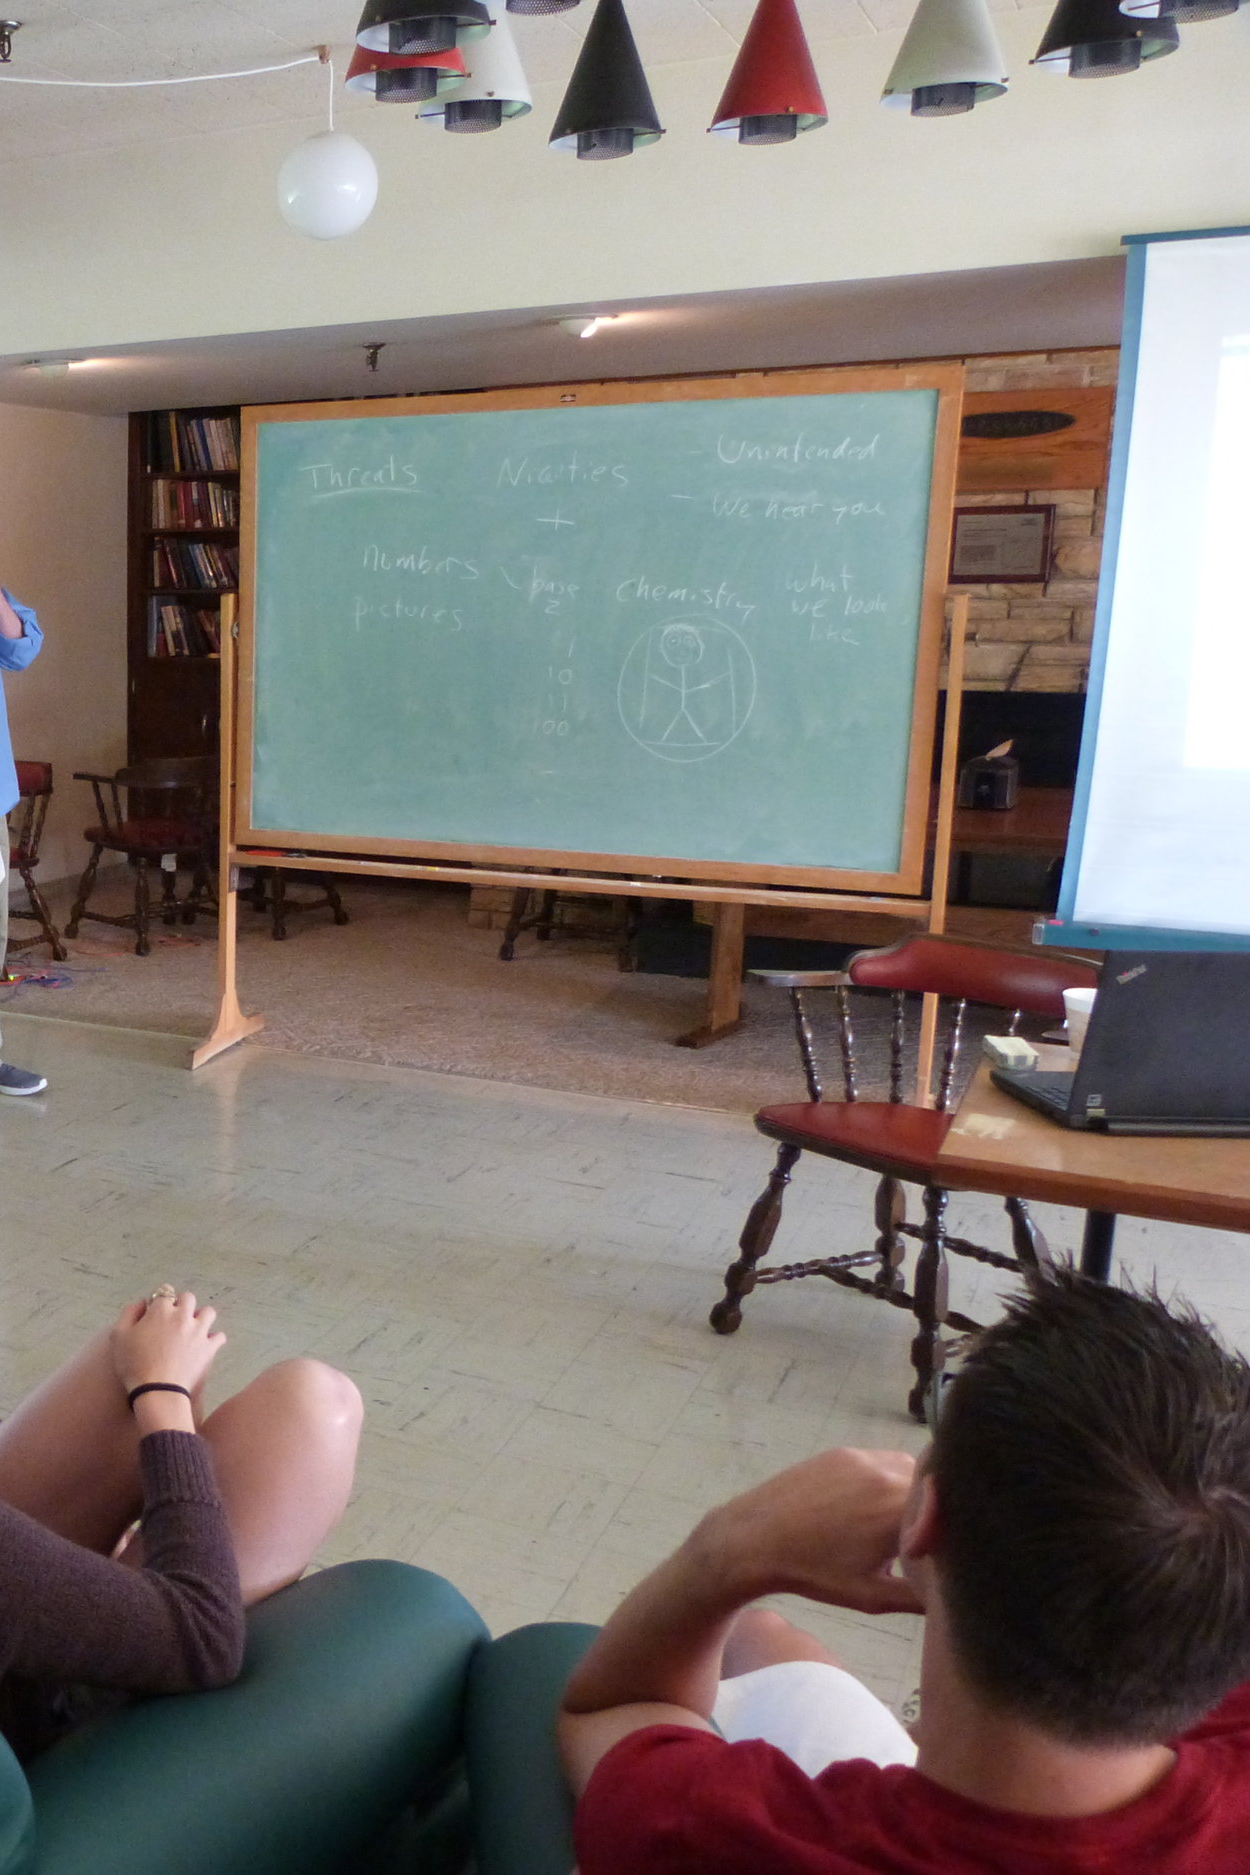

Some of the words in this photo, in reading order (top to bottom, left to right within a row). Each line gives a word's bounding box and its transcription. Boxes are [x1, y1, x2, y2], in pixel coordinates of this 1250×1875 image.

[717, 432, 880, 463] Unintended
[299, 456, 418, 488] Threats
[832, 501, 886, 525] you
